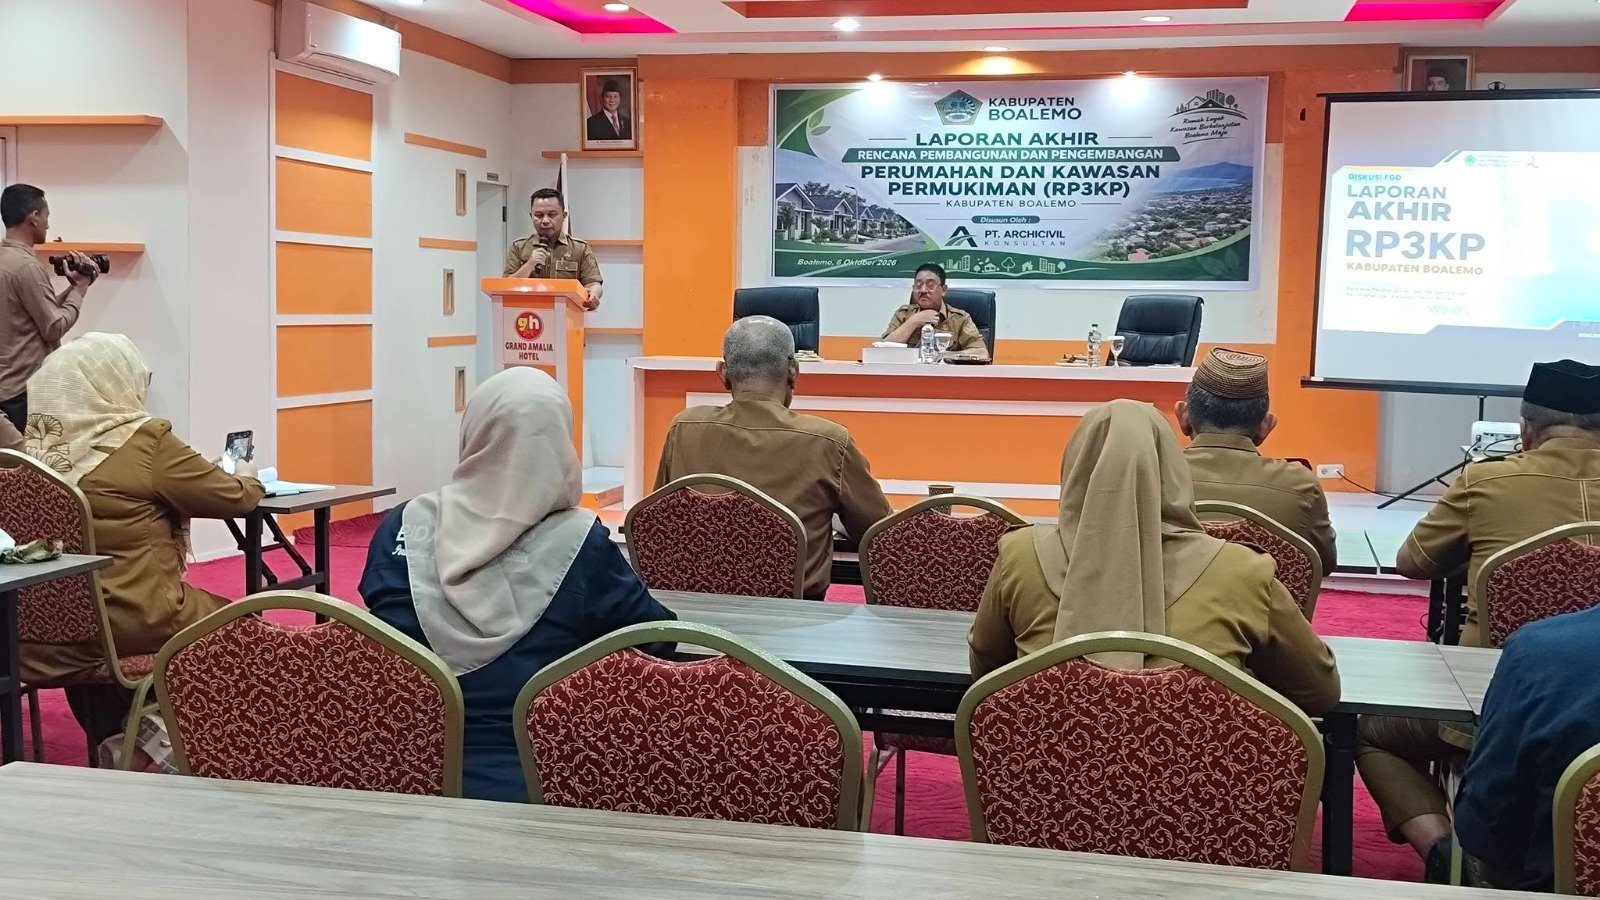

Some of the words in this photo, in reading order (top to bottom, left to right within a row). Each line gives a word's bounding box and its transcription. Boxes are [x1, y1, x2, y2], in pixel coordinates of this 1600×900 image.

[988, 97, 1075, 107] KABUPATEN
[988, 108, 1082, 121] BOALEMO
[1183, 116, 1204, 124] Rumah
[1199, 121, 1241, 130] Berkelanjutan
[916, 132, 1022, 146] LAPORAN
[1028, 132, 1100, 146] AKHIR
[857, 150, 917, 160] RENCANA
[920, 150, 1018, 160] PEMBANGUNAN
[1020, 150, 1048, 160] DAN
[1051, 149, 1164, 160] PENGEMBANGAN
[861, 165, 993, 179] PERUMAHAN
[1001, 165, 1045, 179] DAN
[1052, 165, 1160, 179] KAWASAN
[1348, 173, 1382, 181] DISKUSI
[888, 182, 1036, 196] PERMUKIMAN
[1044, 181, 1130, 198] (RP3KP)
[1347, 184, 1447, 199] LAPORAN
[946, 200, 1014, 208] KABUPATEN
[1019, 200, 1077, 208] BOALEMO
[1347, 201, 1452, 222] AKHIR
[984, 230, 1001, 239] PT.
[1004, 230, 1066, 239] ARCHICIVIL
[1346, 229, 1486, 261] RP3KP
[797, 259, 834, 267] Boalemo,
[1347, 262, 1420, 273] KABUPATEN
[1423, 265, 1484, 275] BOALEMO
[505, 342, 527, 350] GRAND
[528, 342, 554, 351] AMALIA
[518, 352, 540, 361] HOTEL
